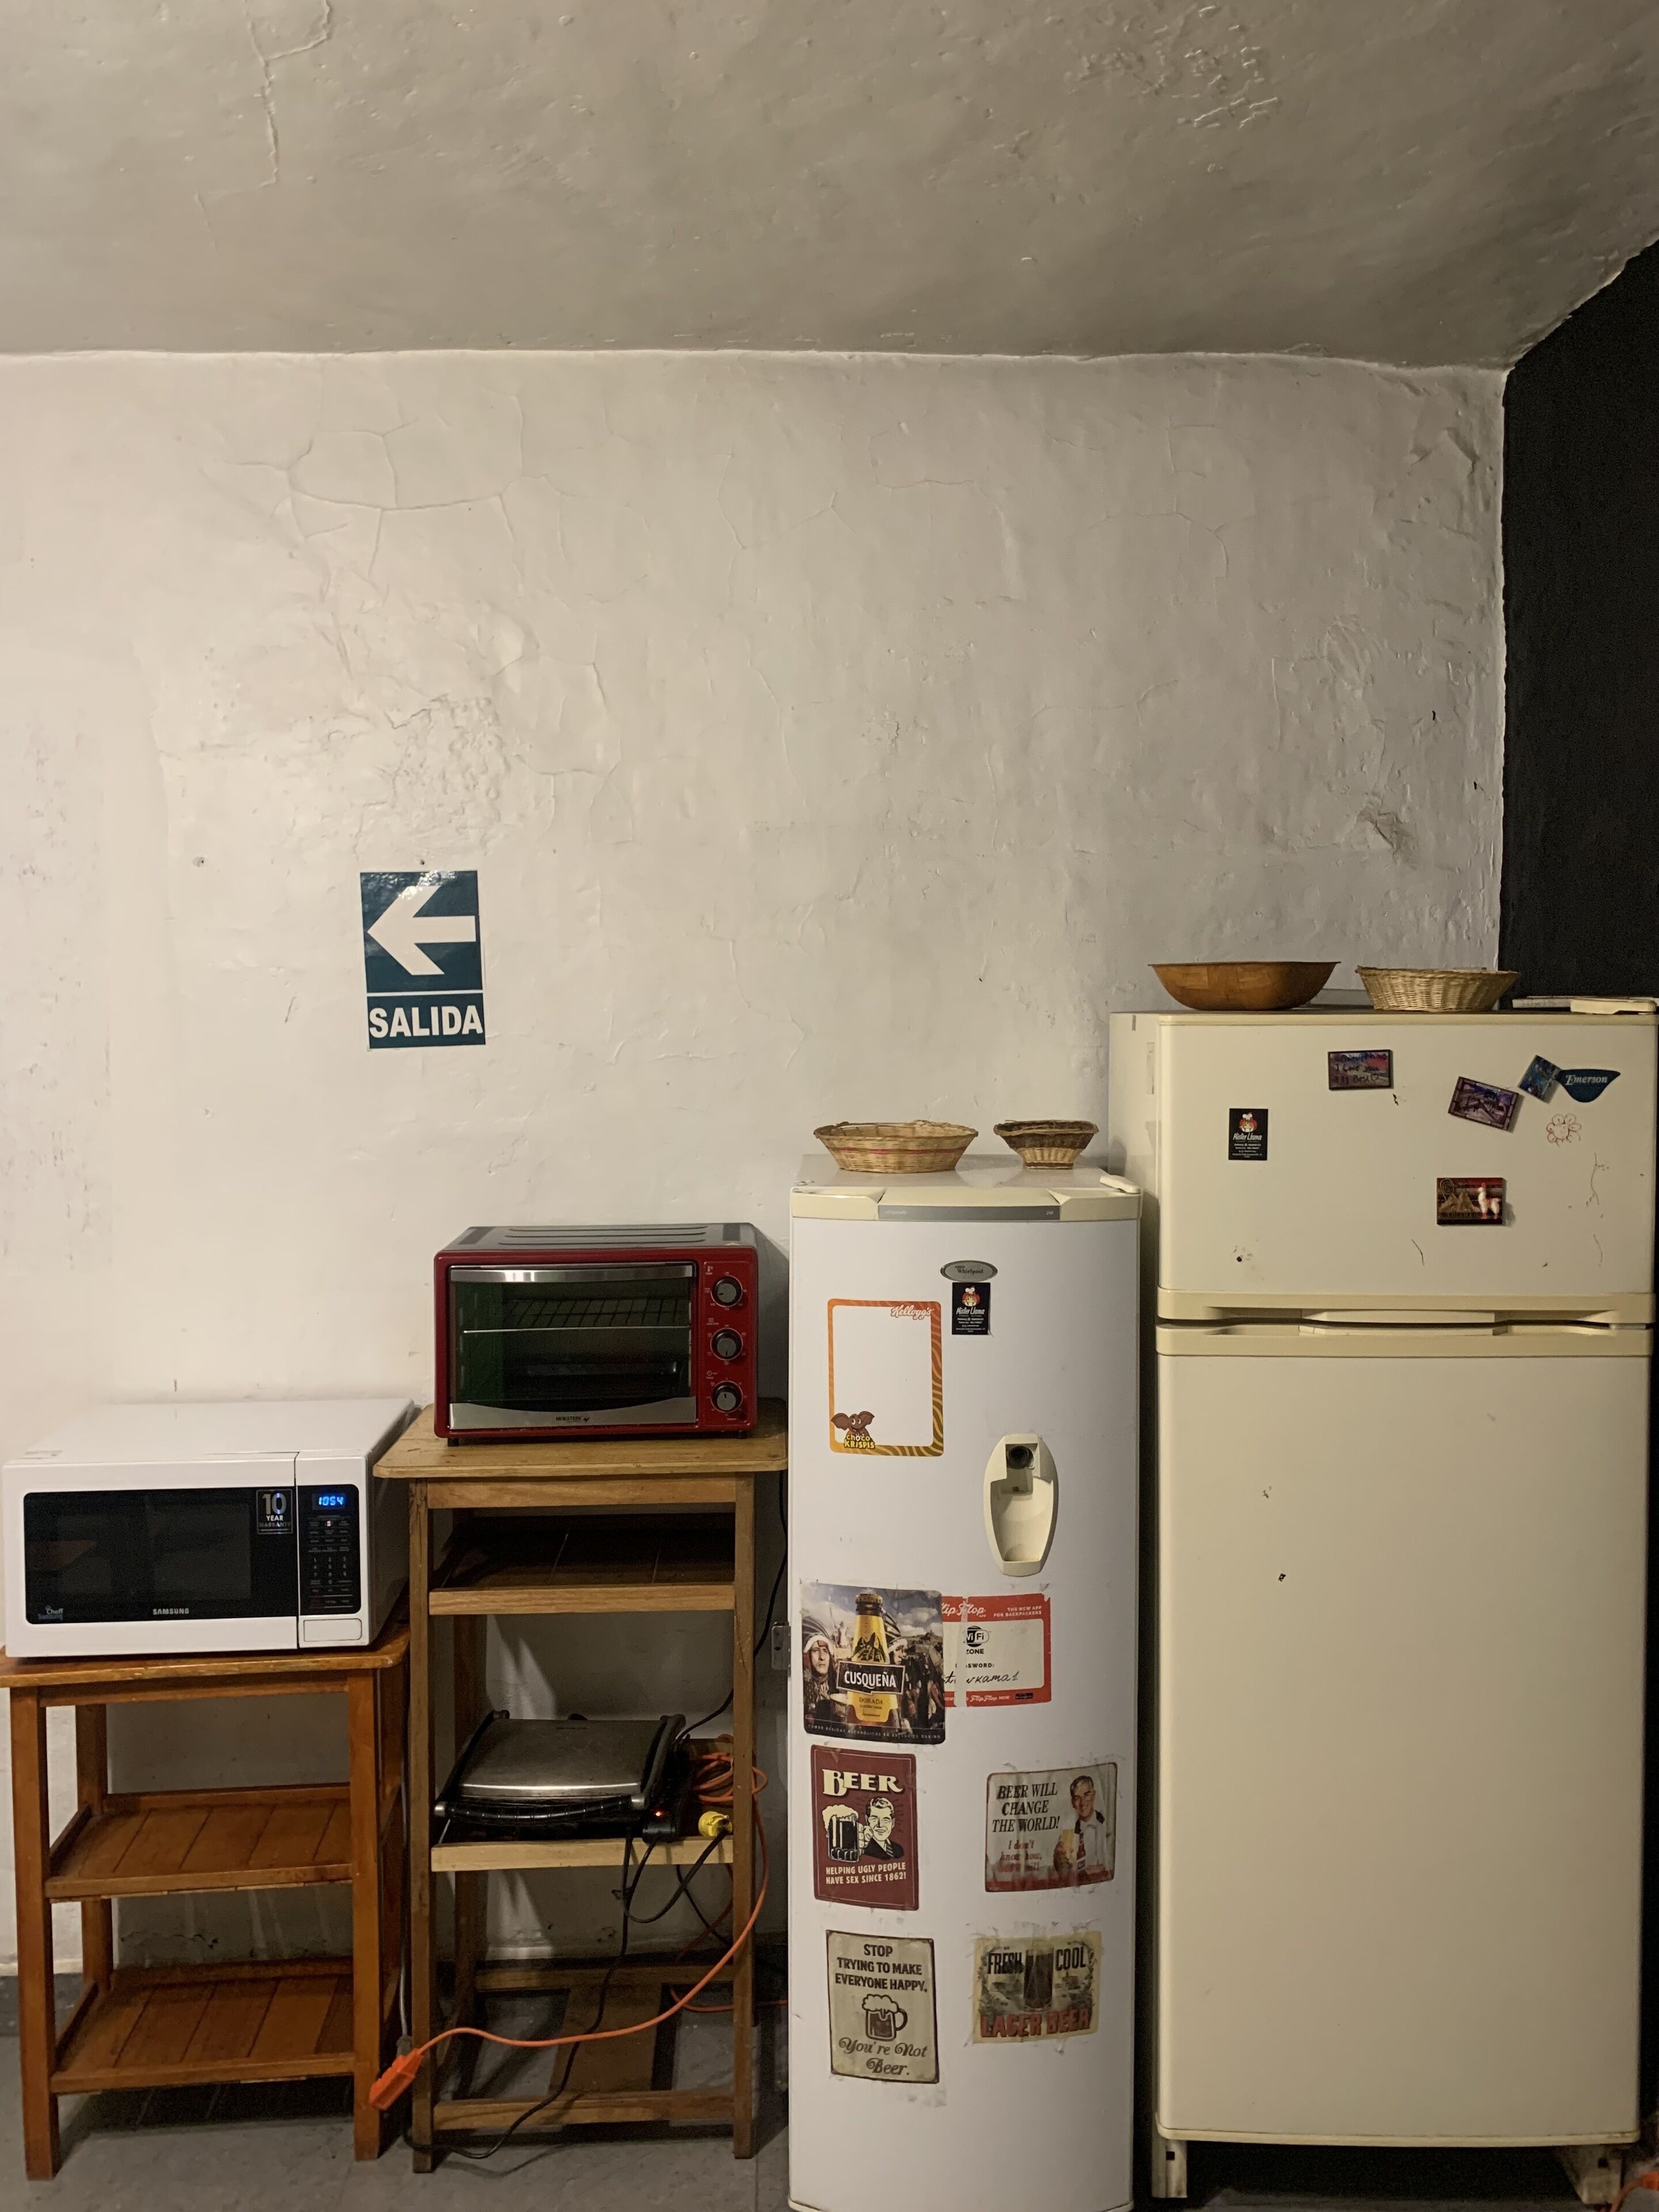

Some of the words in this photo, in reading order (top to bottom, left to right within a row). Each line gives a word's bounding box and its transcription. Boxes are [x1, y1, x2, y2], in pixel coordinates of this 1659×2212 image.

[369, 1005, 483, 1039] SALIDA
[1565, 1074, 1608, 1086] Emerson
[1233, 1132, 1248, 1141] Mister
[891, 1304, 932, 1320] Kellogg's
[956, 1306, 971, 1315] Mister
[969, 1306, 985, 1315] Llama
[844, 1439, 876, 1449] KRISPIS
[262, 1493, 287, 1515] 10
[941, 1603, 958, 1616] lip
[844, 1671, 897, 1689] CUSQUEÑA
[859, 1696, 883, 1705] DORADA
[821, 1768, 903, 1797] BEER
[996, 1785, 1029, 1800] BEER
[1031, 1782, 1058, 1798] WILL
[1001, 1800, 1050, 1816] CHANGE
[992, 1819, 1016, 1832] THE
[1017, 1816, 1060, 1832] WORLD!
[825, 1866, 855, 1875] HELPING
[858, 1864, 876, 1873] UGLY
[878, 1862, 906, 1872] PEOPLE
[825, 1876, 844, 1884] HAVE
[846, 1876, 859, 1884] SEX
[861, 1874, 882, 1884] SINCE
[884, 1872, 907, 1881] 1862!
[863, 1944, 893, 1957] STOP
[1054, 1946, 1086, 1971] COOL
[836, 1957, 874, 1972] TRYING
[876, 1961, 891, 1974] TO
[892, 1963, 922, 1976] MAKE
[835, 1973, 888, 1989] EVERYONE
[889, 1978, 928, 1993] HAPPY,
[980, 2013, 1043, 2038] LAGER
[1046, 2008, 1091, 2035] BEER
[838, 2036, 891, 2055] You're
[894, 2042, 928, 2058] Not
[866, 2057, 910, 2075] Beer.
